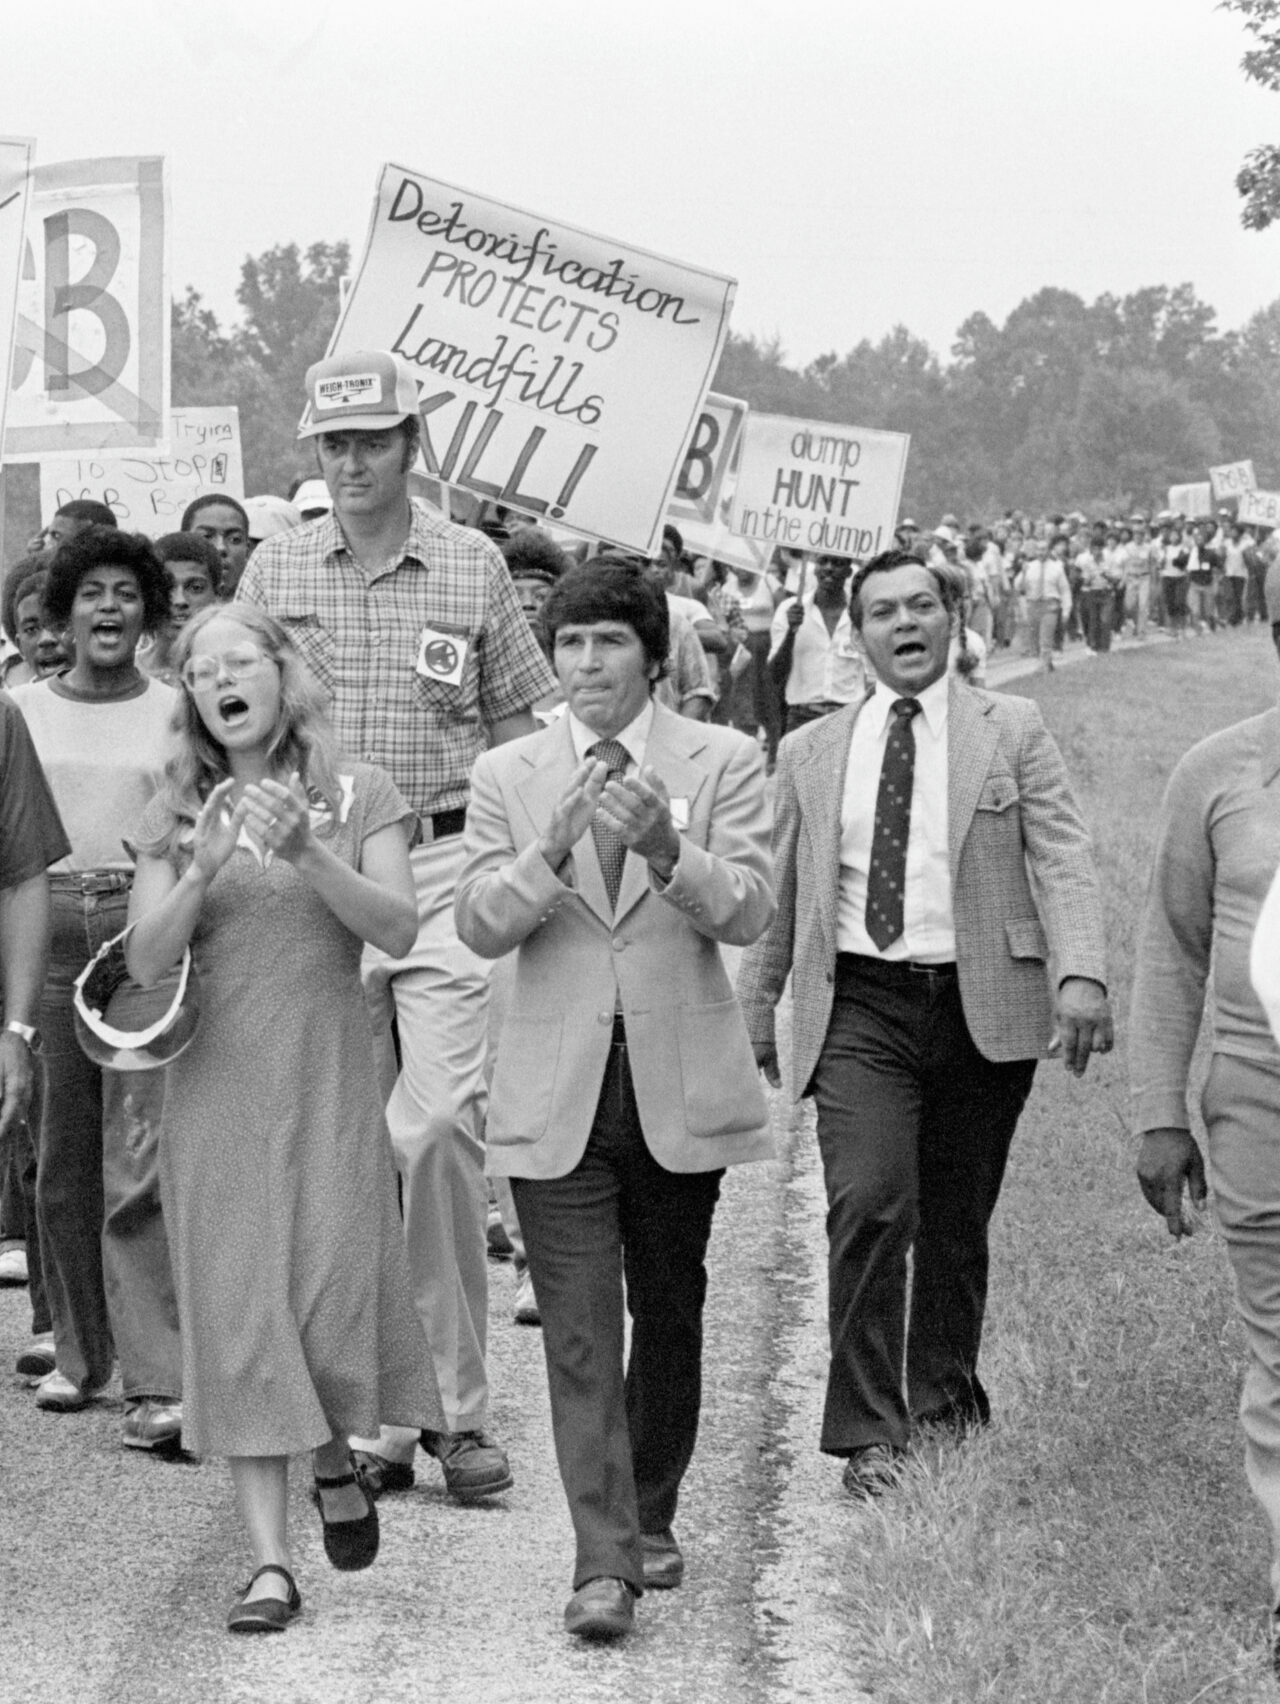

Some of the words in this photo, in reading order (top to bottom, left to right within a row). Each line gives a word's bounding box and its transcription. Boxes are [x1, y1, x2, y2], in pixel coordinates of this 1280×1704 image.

[387, 178, 700, 324] Detoxification
[417, 250, 620, 352] PROTECTS
[390, 303, 605, 425] Landfills
[790, 430, 861, 478] dump
[772, 467, 861, 518] HUNT
[807, 516, 883, 559] dump!
